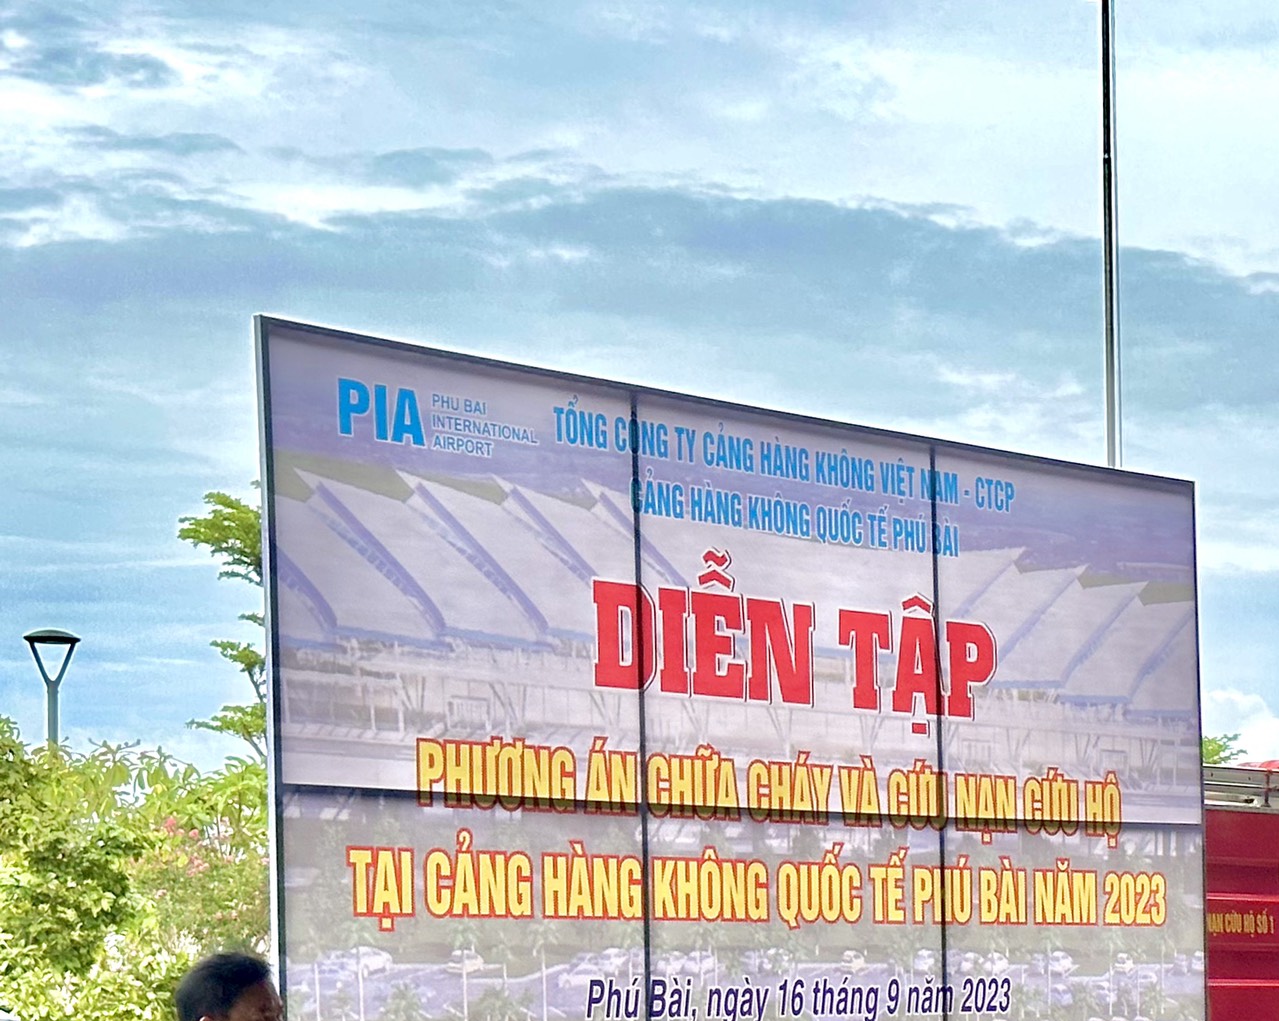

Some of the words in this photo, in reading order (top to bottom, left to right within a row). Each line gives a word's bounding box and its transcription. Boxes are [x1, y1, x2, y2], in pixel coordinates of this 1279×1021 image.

[337, 377, 425, 447] PIA
[432, 394, 461, 409] PHU
[464, 399, 487, 414] BAI
[432, 416, 539, 444] INTERNATIONAL
[433, 433, 493, 457] AIRPORT
[554, 394, 607, 449] TỔNG
[675, 427, 696, 463] TY
[703, 421, 754, 473] CẢNG
[760, 433, 809, 481] HÀNG
[815, 450, 875, 493] KHÔNG
[880, 457, 915, 506] VIỆT
[920, 463, 958, 505] NAM
[975, 479, 1015, 513] CTCP
[630, 468, 684, 520] CẢNG
[690, 481, 741, 528] HÀNG
[748, 493, 810, 539] KHÔNG
[816, 498, 864, 546] QUỐC
[868, 505, 888, 548] TẾ
[893, 516, 926, 554] PHÚ
[931, 517, 959, 557] BÀI
[593, 548, 812, 703] DIỄN
[838, 593, 994, 735] TẬP
[416, 736, 577, 814] PHƯƠNG
[584, 736, 638, 815] ÁN
[645, 744, 740, 821] CHỮA
[748, 751, 831, 825] CHÁY
[838, 755, 881, 828] VÀ
[887, 759, 947, 830] CỨU
[955, 773, 1017, 844] NẠN
[1023, 767, 1079, 835] CỨU
[1085, 771, 1122, 848] HỘ
[347, 845, 415, 932] TẠI
[424, 827, 533, 918] CẢNG
[542, 840, 642, 920] HÀNG
[651, 846, 768, 921] KHÔNG
[777, 843, 863, 929] QUỐC
[869, 847, 909, 924] TẾ
[912, 855, 972, 925] PHÚ
[980, 856, 1027, 925] BÀI
[1033, 858, 1098, 925] NĂM
[1103, 872, 1167, 926] 2023
[1243, 910, 1255, 938] HỘ
[1257, 908, 1268, 935] SỐ
[1269, 915, 1274, 934] 1
[586, 979, 641, 1021] Phú
[778, 977, 804, 1016] 16
[887, 977, 899, 1014] 9
[907, 978, 954, 1015] năm
[960, 977, 1012, 1013] 2023
